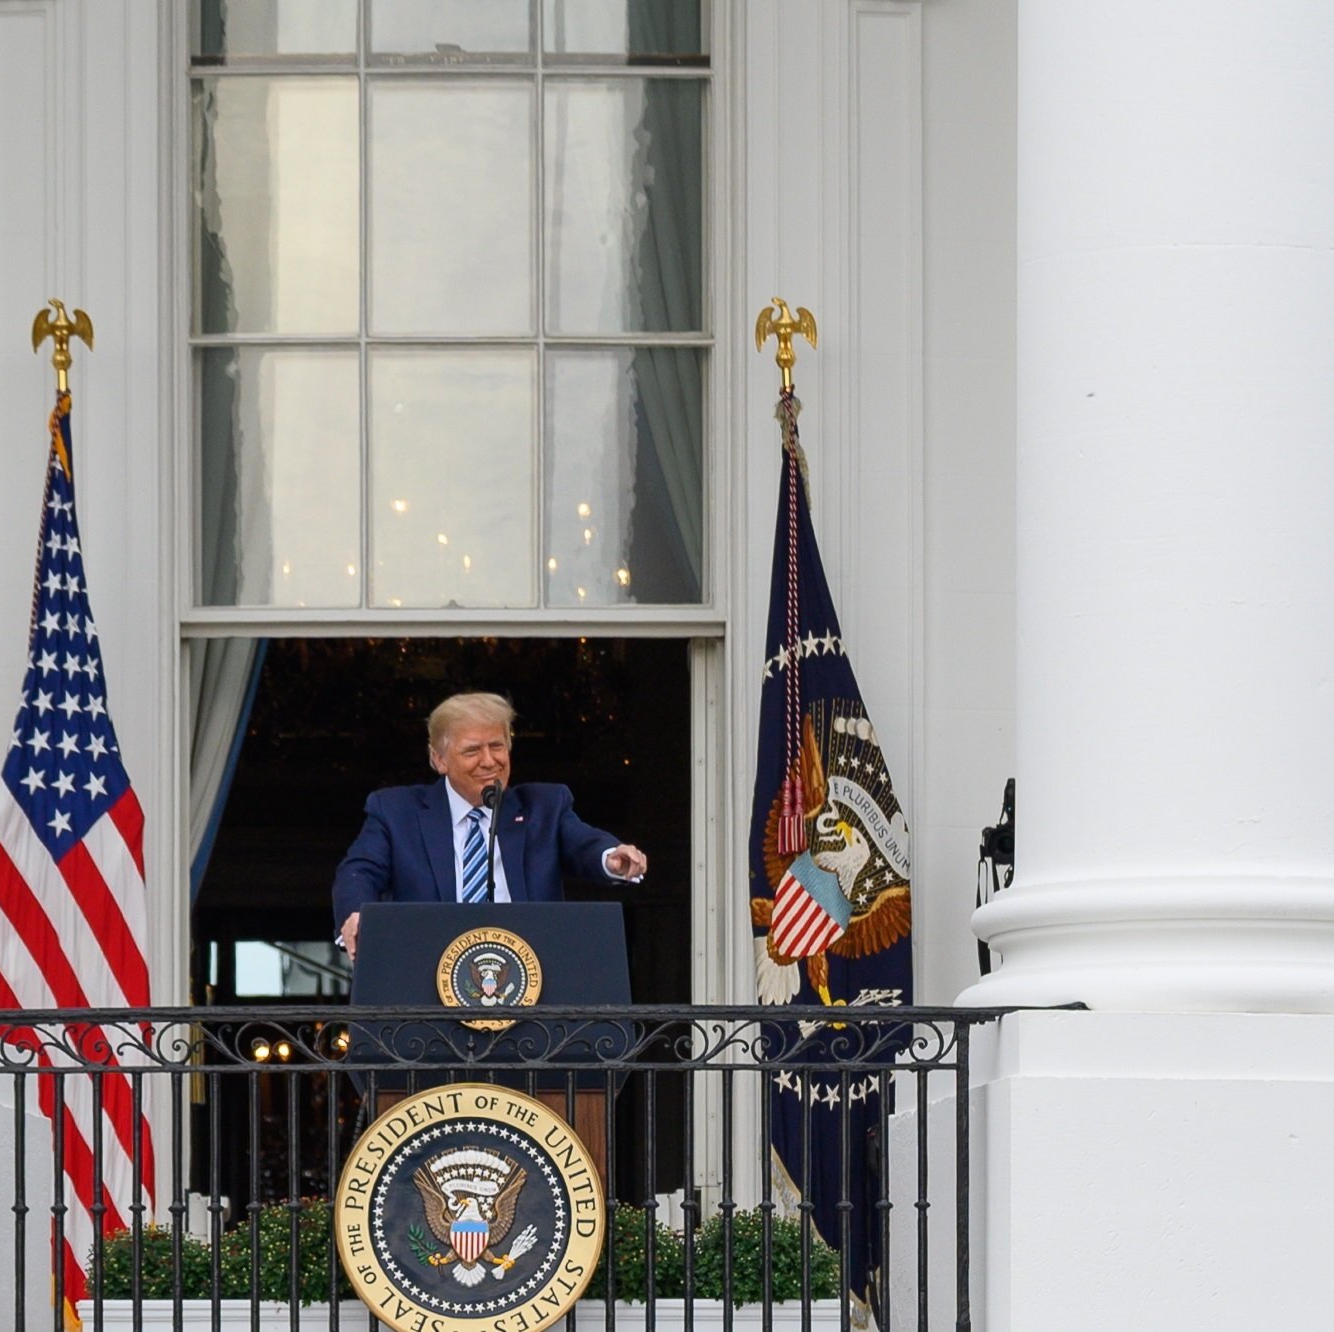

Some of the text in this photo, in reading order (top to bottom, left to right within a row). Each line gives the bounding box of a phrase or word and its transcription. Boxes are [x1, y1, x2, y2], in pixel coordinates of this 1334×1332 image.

[834, 782, 911, 873] E PLURIBUS UNUM
[441, 931, 489, 975] PRESIDENT
[503, 935, 517, 947] THE
[518, 945, 539, 988] UNITED
[474, 1095, 499, 1110] OF
[506, 1101, 539, 1128] THE
[344, 1092, 463, 1211] PRESIDENT
[543, 1125, 597, 1238] UNITED
[347, 1223, 365, 1257] THE
[357, 1265, 378, 1285] OF
